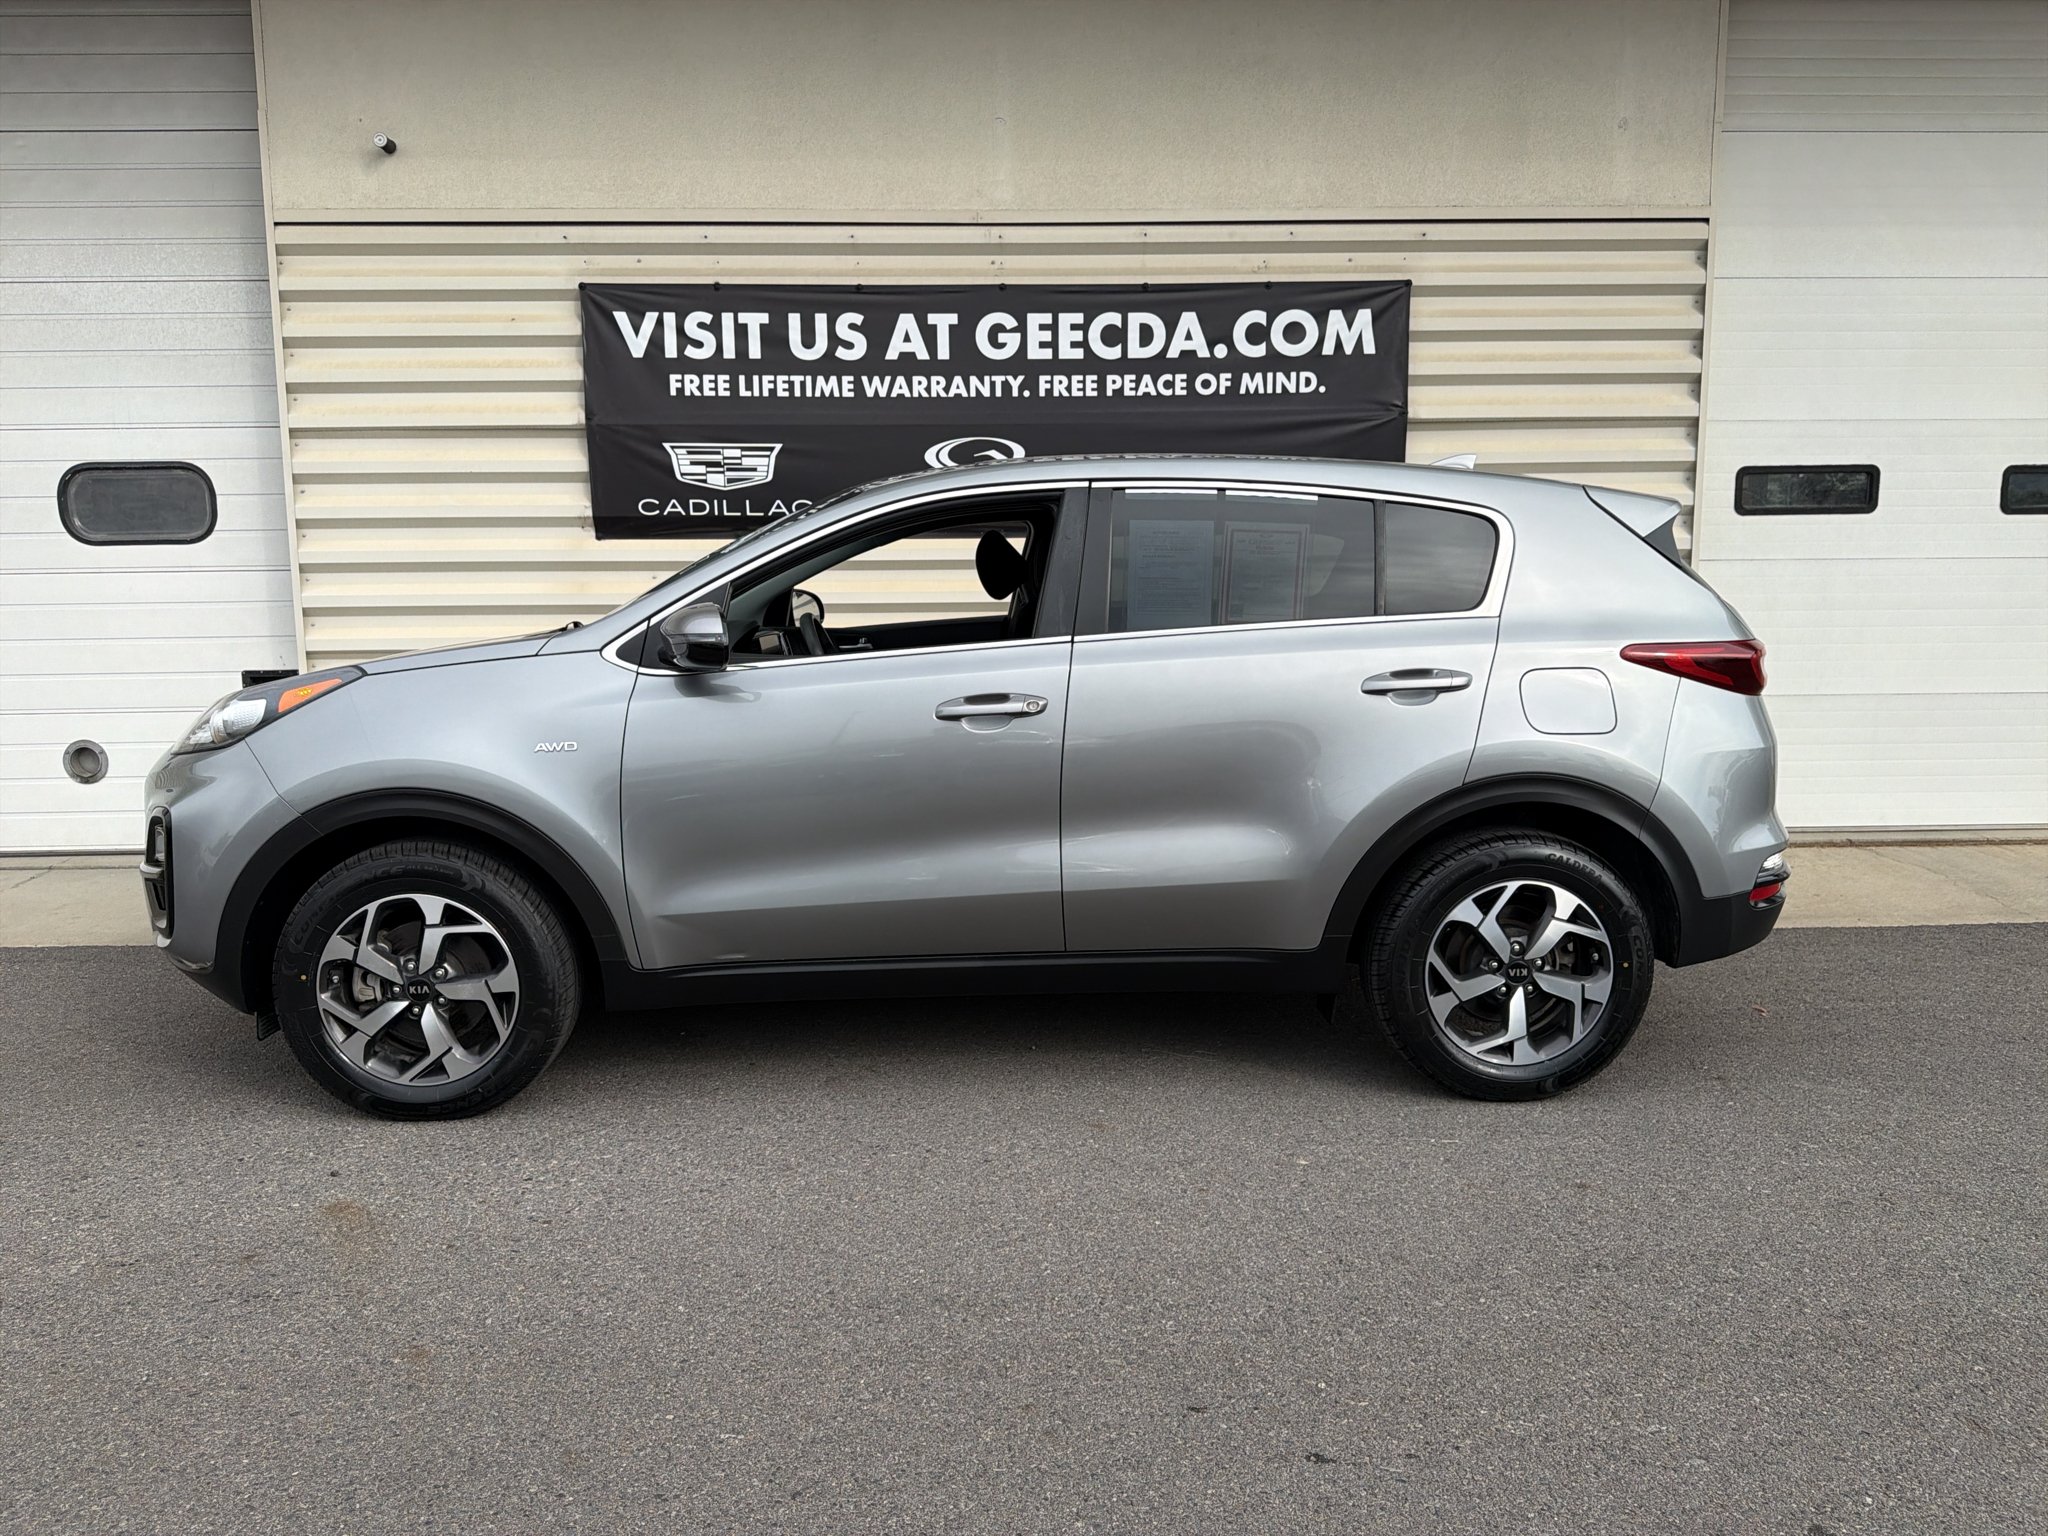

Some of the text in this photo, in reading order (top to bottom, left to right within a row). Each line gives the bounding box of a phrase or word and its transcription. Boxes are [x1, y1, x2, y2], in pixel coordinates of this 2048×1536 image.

[612, 308, 1377, 361] VISIT US AT GEECDA.COM
[669, 371, 1326, 398] FREE LIFETIME WARRANTY. FREE PEACE OF MIND.
[534, 741, 578, 752] AWD
[1509, 967, 1528, 976] KIA
[409, 985, 430, 994] KIA
